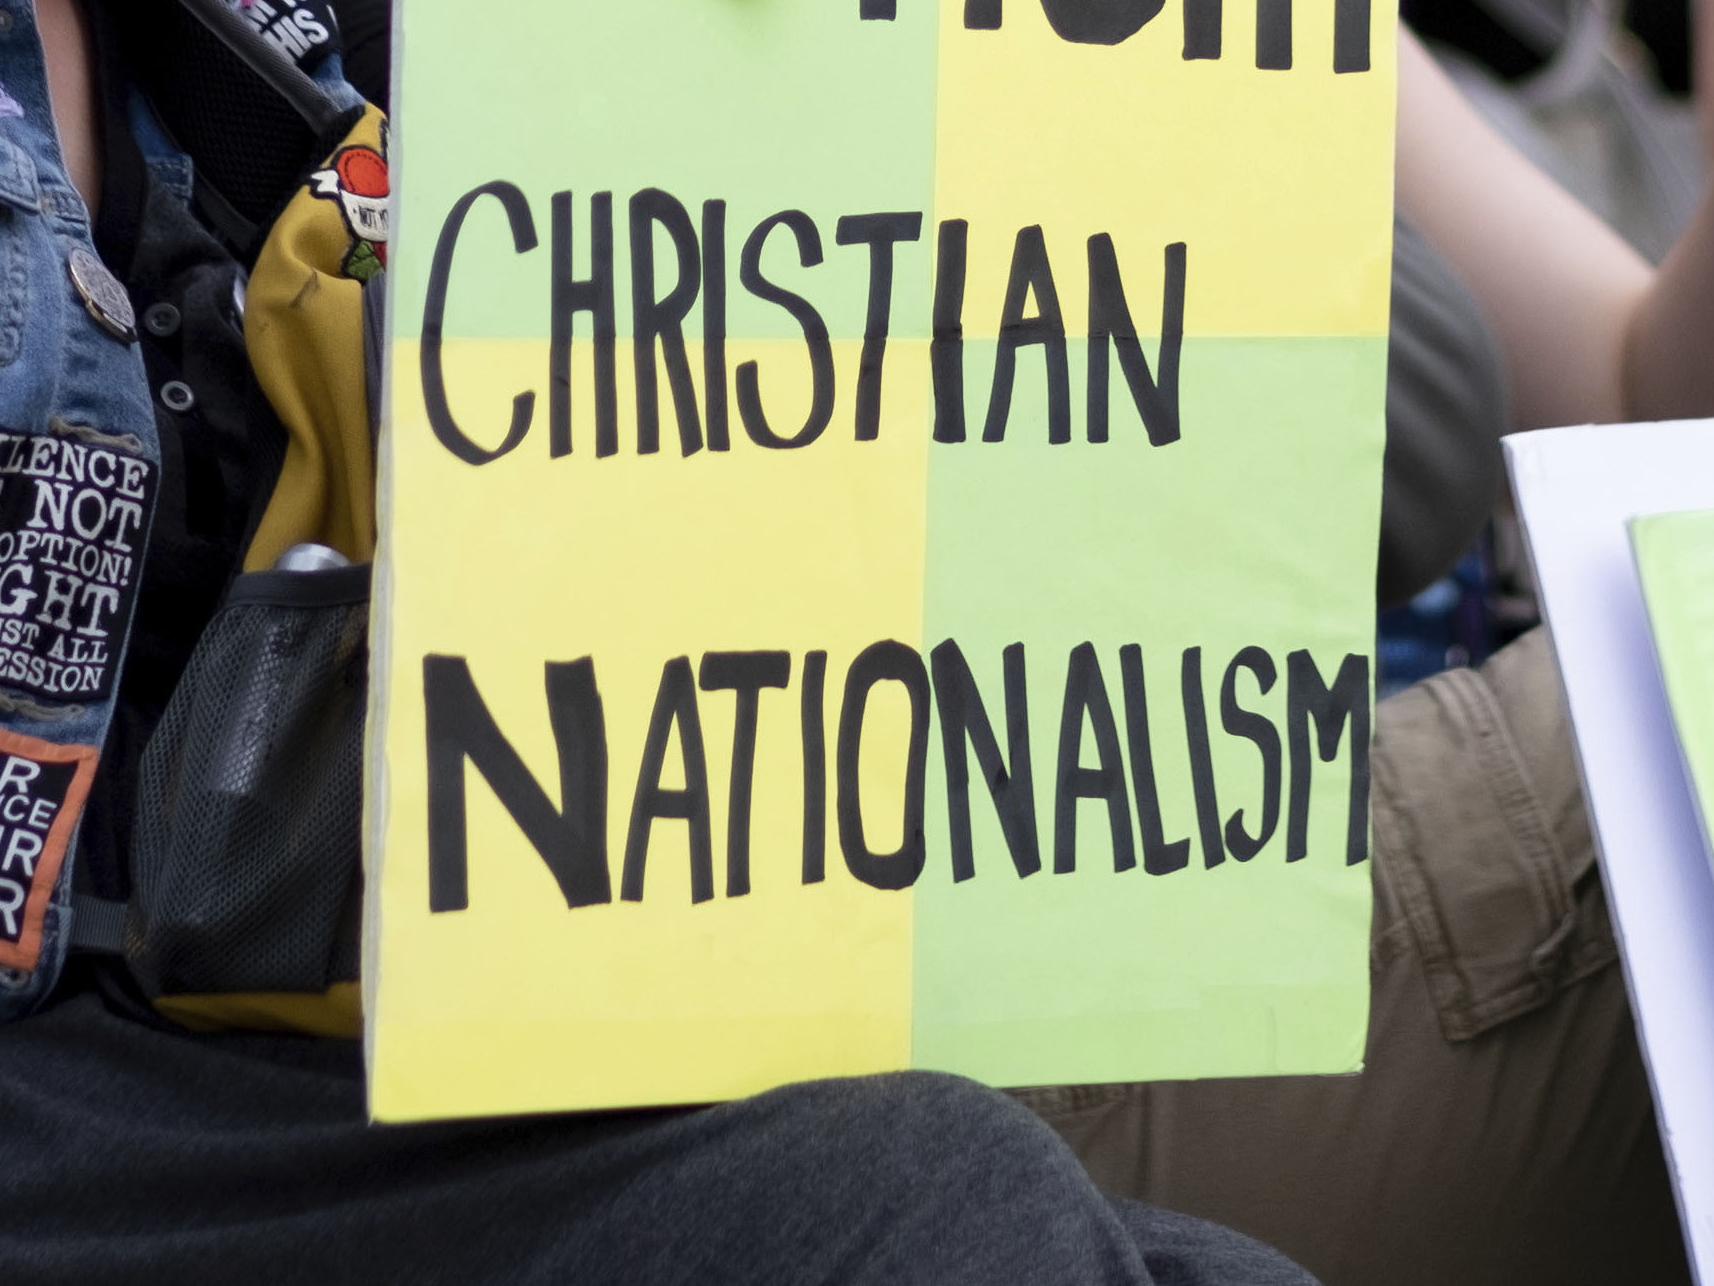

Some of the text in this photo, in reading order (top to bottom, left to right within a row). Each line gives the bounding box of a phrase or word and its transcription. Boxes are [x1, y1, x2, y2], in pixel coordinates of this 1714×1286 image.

[420, 177, 1188, 466] CHRISTIAN
[26, 479, 143, 552] NOT
[47, 633, 109, 664] ALL
[421, 636, 1372, 916] NATIONALISM
